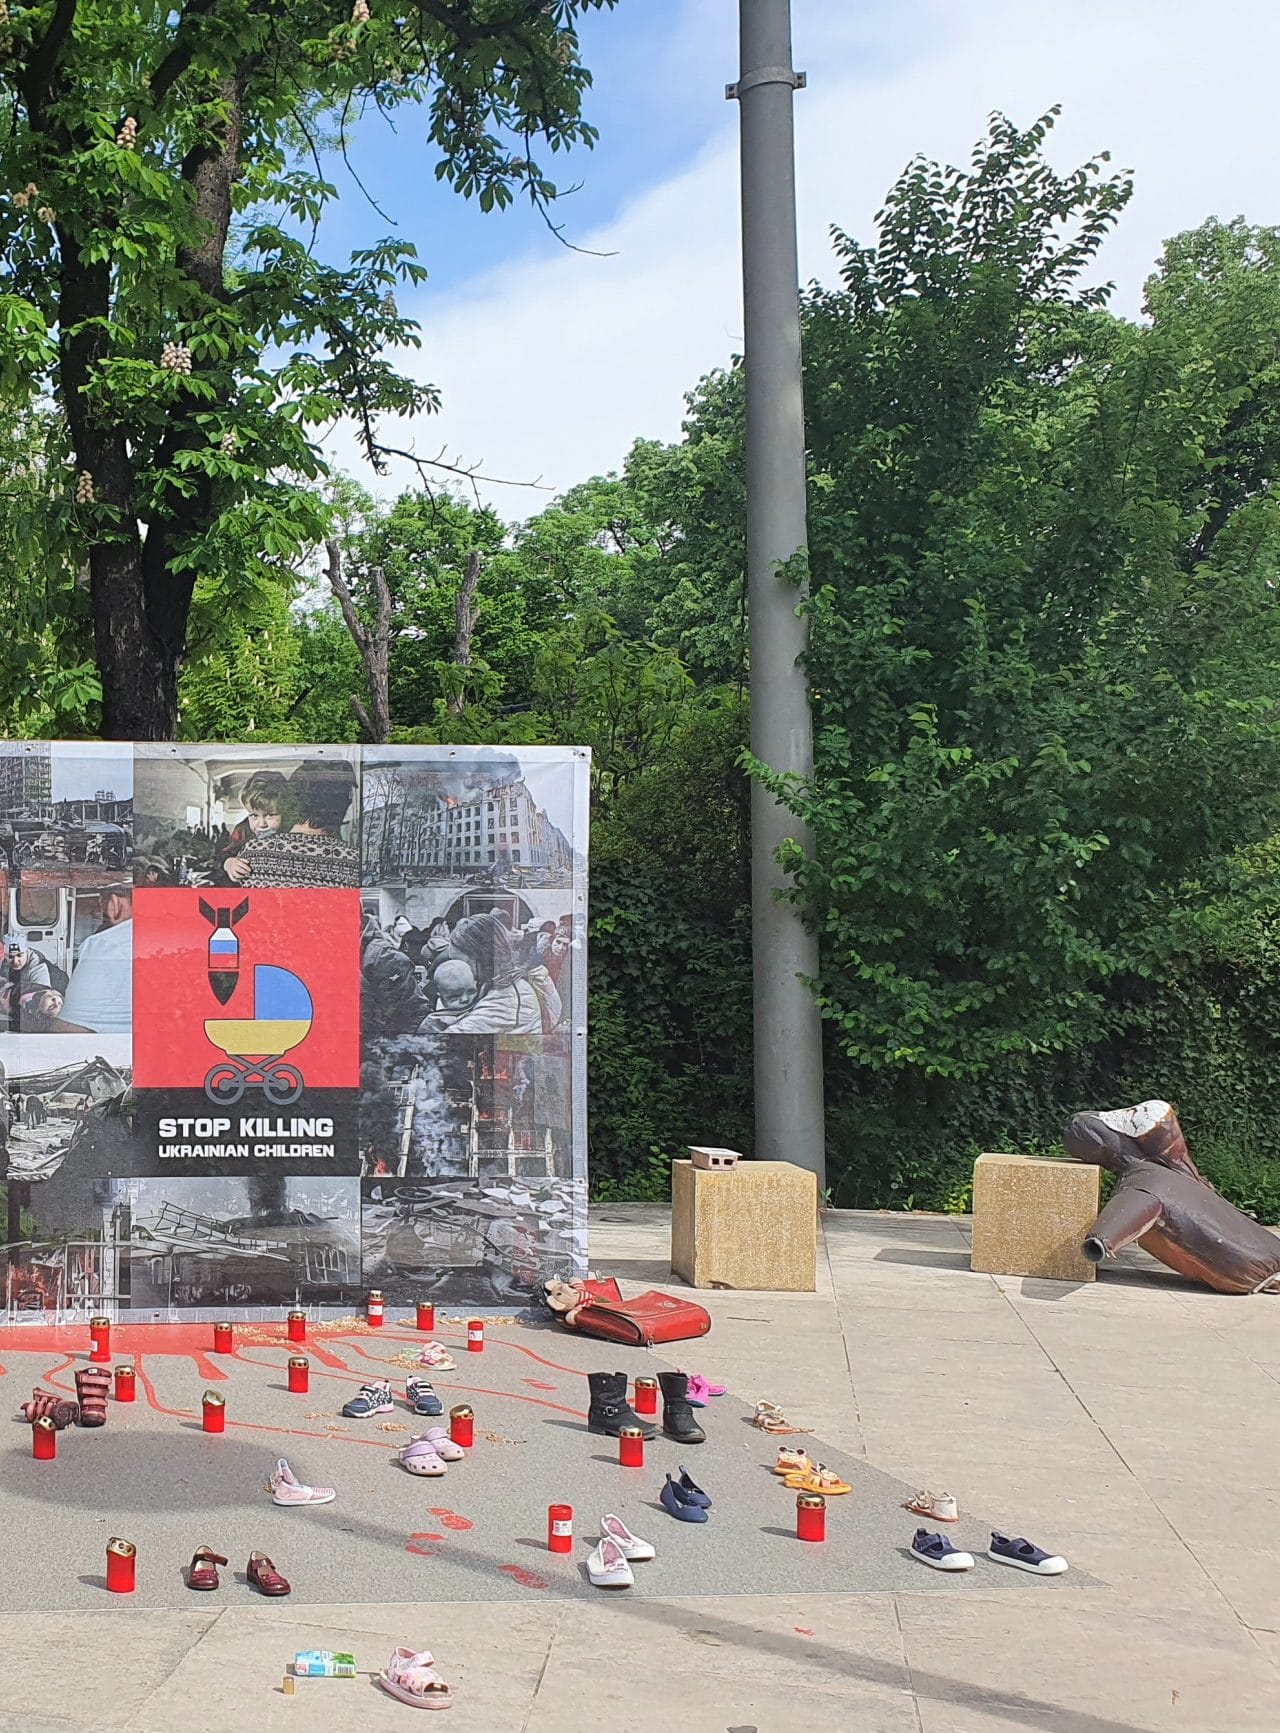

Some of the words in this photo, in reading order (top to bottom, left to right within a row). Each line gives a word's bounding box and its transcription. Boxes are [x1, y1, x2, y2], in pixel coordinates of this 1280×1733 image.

[158, 1118, 231, 1138] STOP
[240, 1118, 334, 1138] KILLING
[158, 1144, 249, 1158] UKRAINIAN
[254, 1144, 335, 1158] CHILDREN
